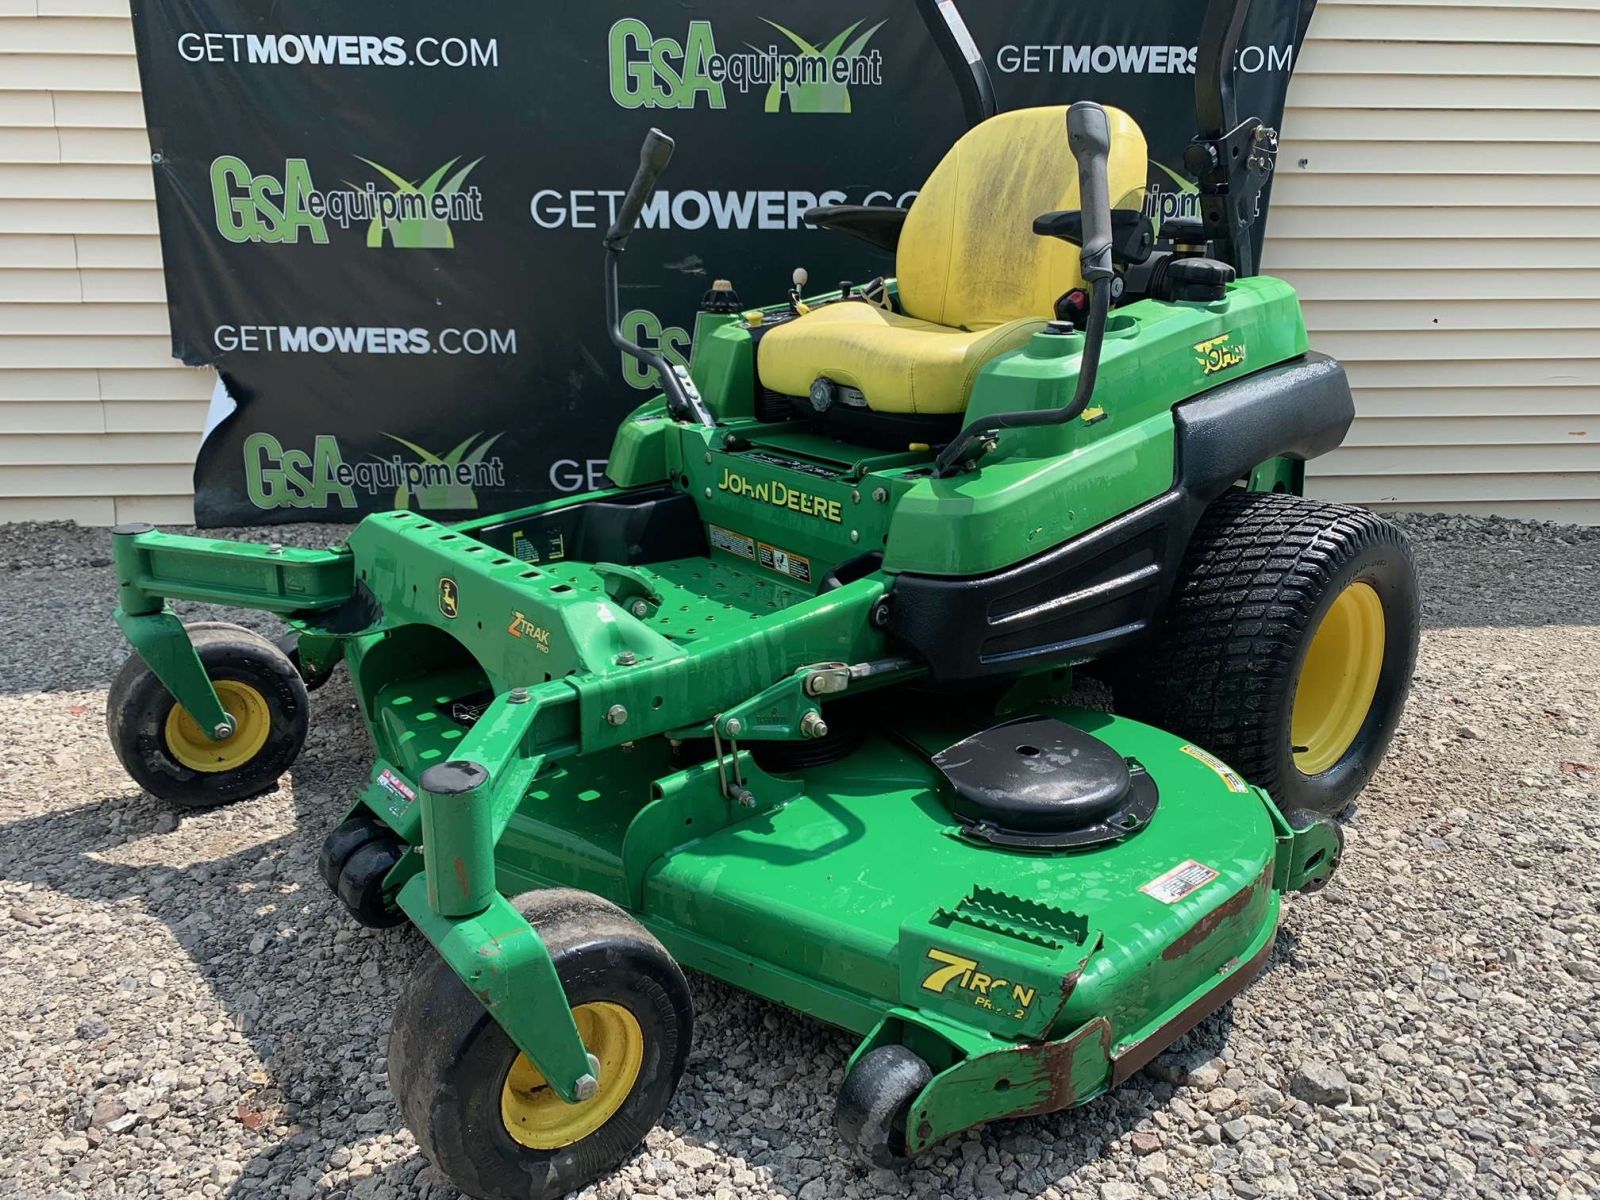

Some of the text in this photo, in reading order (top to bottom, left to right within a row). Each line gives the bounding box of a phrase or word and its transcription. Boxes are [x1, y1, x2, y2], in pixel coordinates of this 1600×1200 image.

[178, 33, 498, 68] GETMOWERS.COM
[214, 324, 518, 355] GETMOWERS.COM
[718, 468, 842, 523] JOHN DEERE
